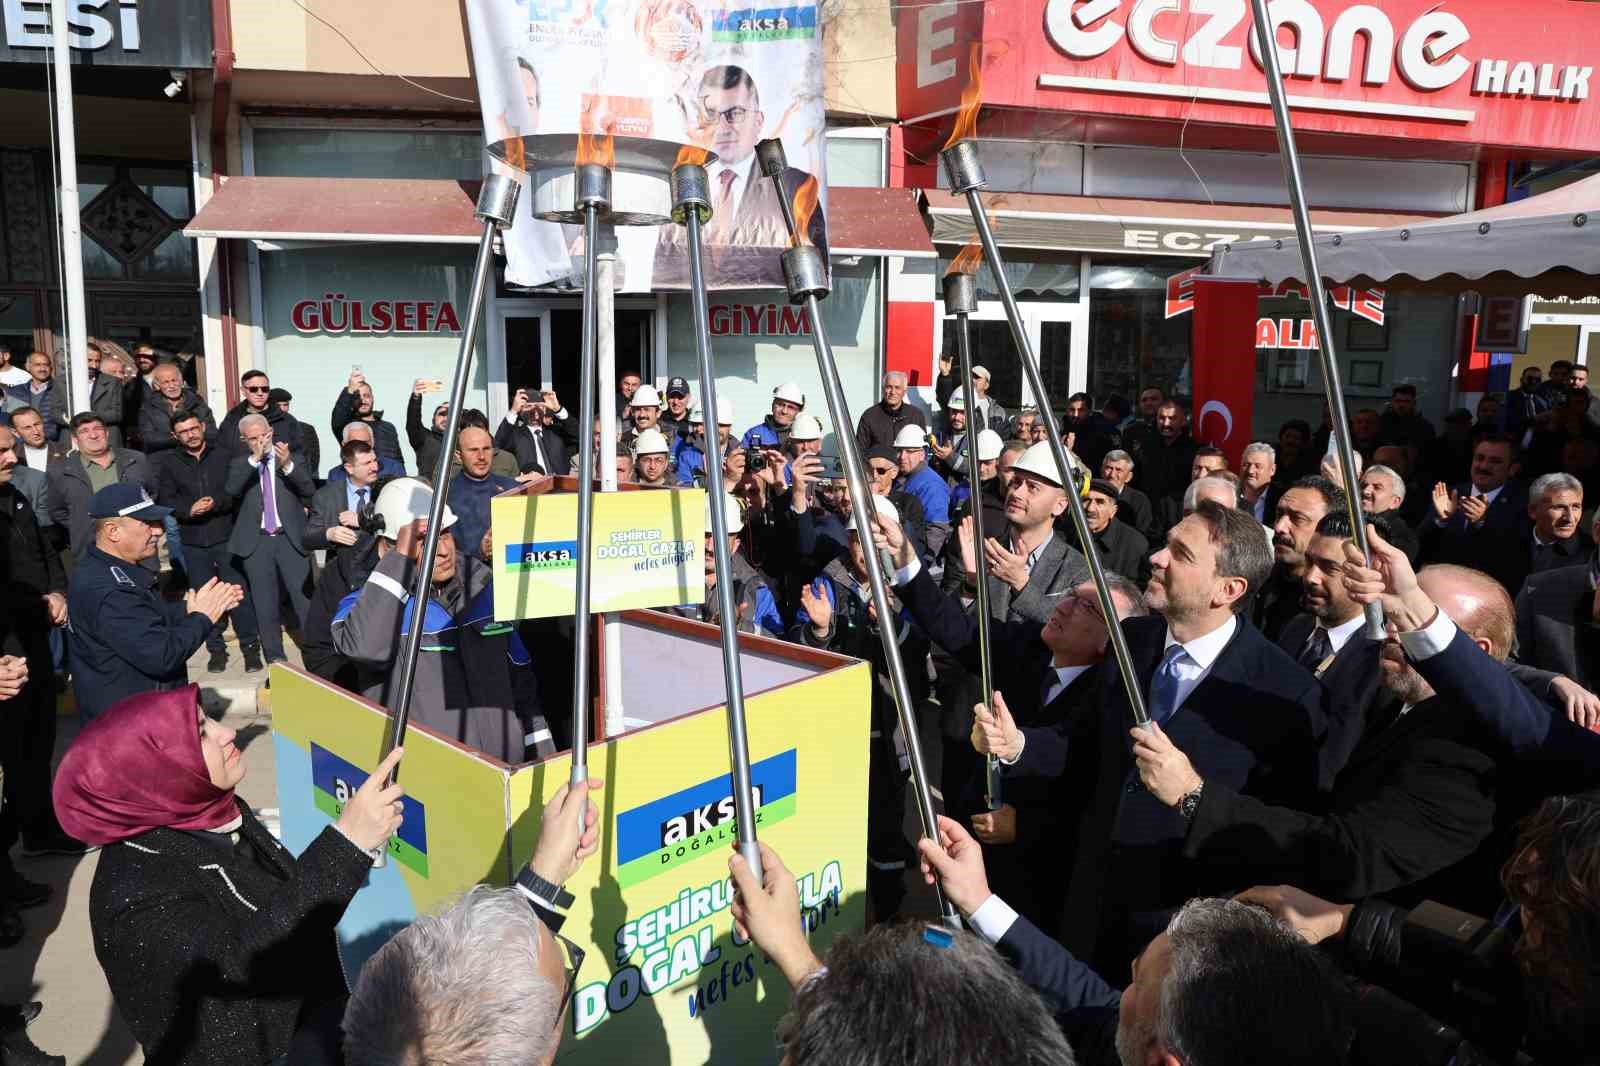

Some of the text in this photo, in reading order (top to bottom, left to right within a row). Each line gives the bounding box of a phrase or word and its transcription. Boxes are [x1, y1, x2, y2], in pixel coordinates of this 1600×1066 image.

[739, 17, 789, 32] aksa
[917, 0, 958, 88] E
[1043, 0, 1472, 92] eczane
[1471, 58, 1593, 102] HALK
[1124, 229, 1270, 252] ECZ
[292, 292, 466, 334] GÜLSEFA
[708, 303, 813, 336] GİYİM
[1256, 318, 1320, 350] ALK
[611, 529, 661, 544] ŞEHİRLER
[650, 540, 695, 556] GAZLA
[525, 549, 571, 563] aksa
[633, 557, 661, 571] nefes
[661, 812, 763, 865] DOĞALGZ
[615, 877, 736, 965] ŞEHİRL
[573, 923, 722, 1036] DOĞAL
[688, 952, 755, 1018] nefes
